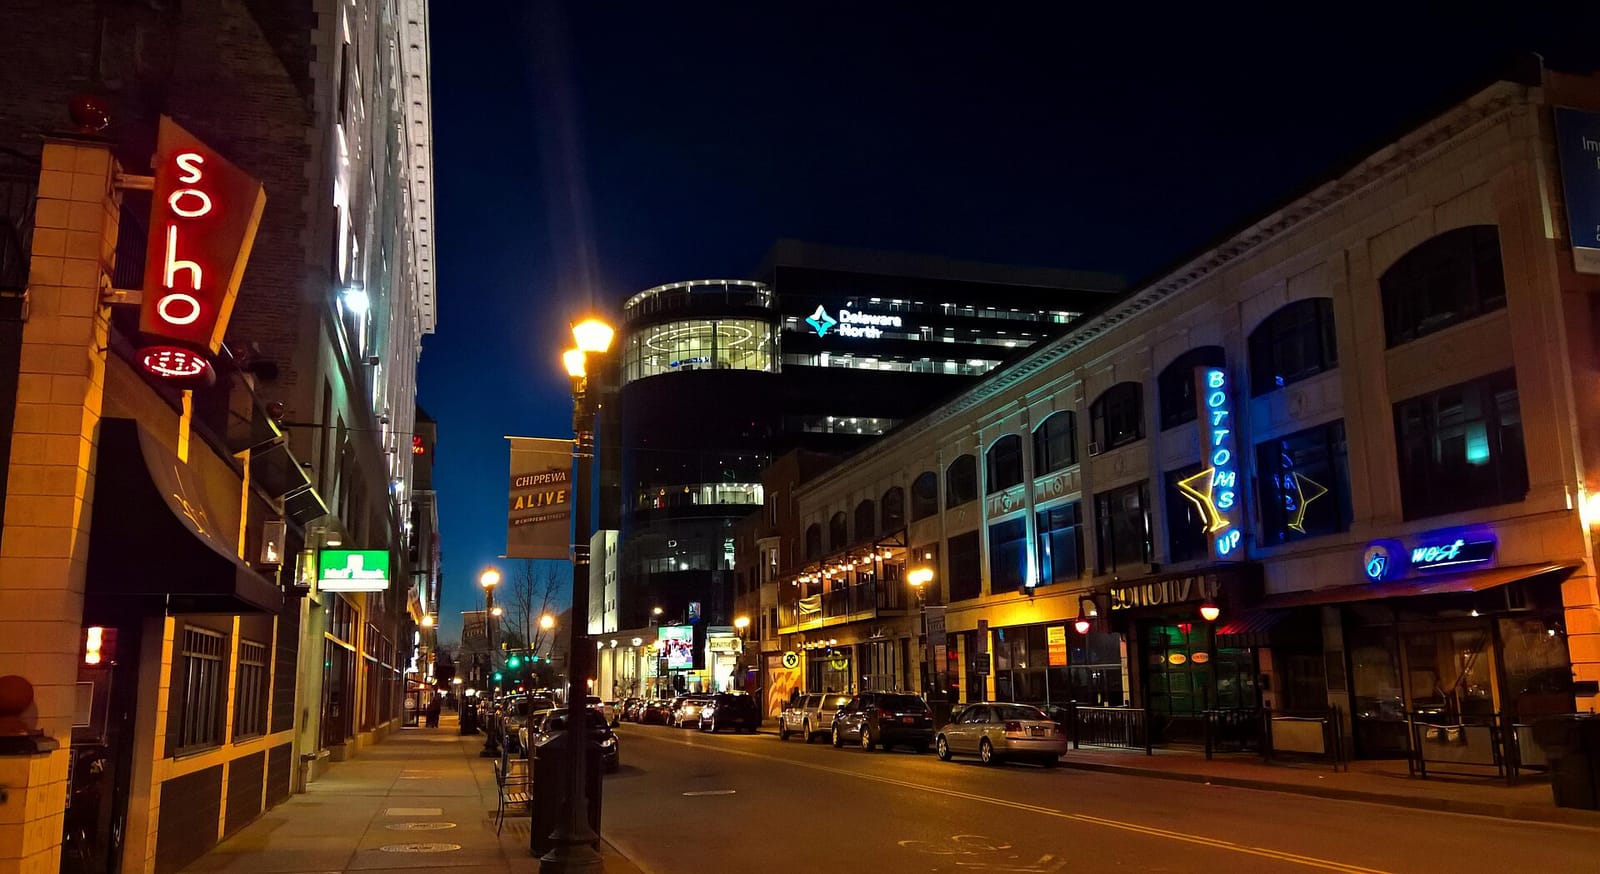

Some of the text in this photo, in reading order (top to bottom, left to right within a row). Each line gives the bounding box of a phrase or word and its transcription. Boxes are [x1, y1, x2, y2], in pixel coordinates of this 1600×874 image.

[157, 152, 212, 325] soho
[839, 309, 902, 327] Delaware
[839, 322, 884, 339] North
[1207, 369, 1241, 555] BOTTOMS UP
[515, 471, 566, 487] CHIPPEWA
[1411, 539, 1465, 563] west
